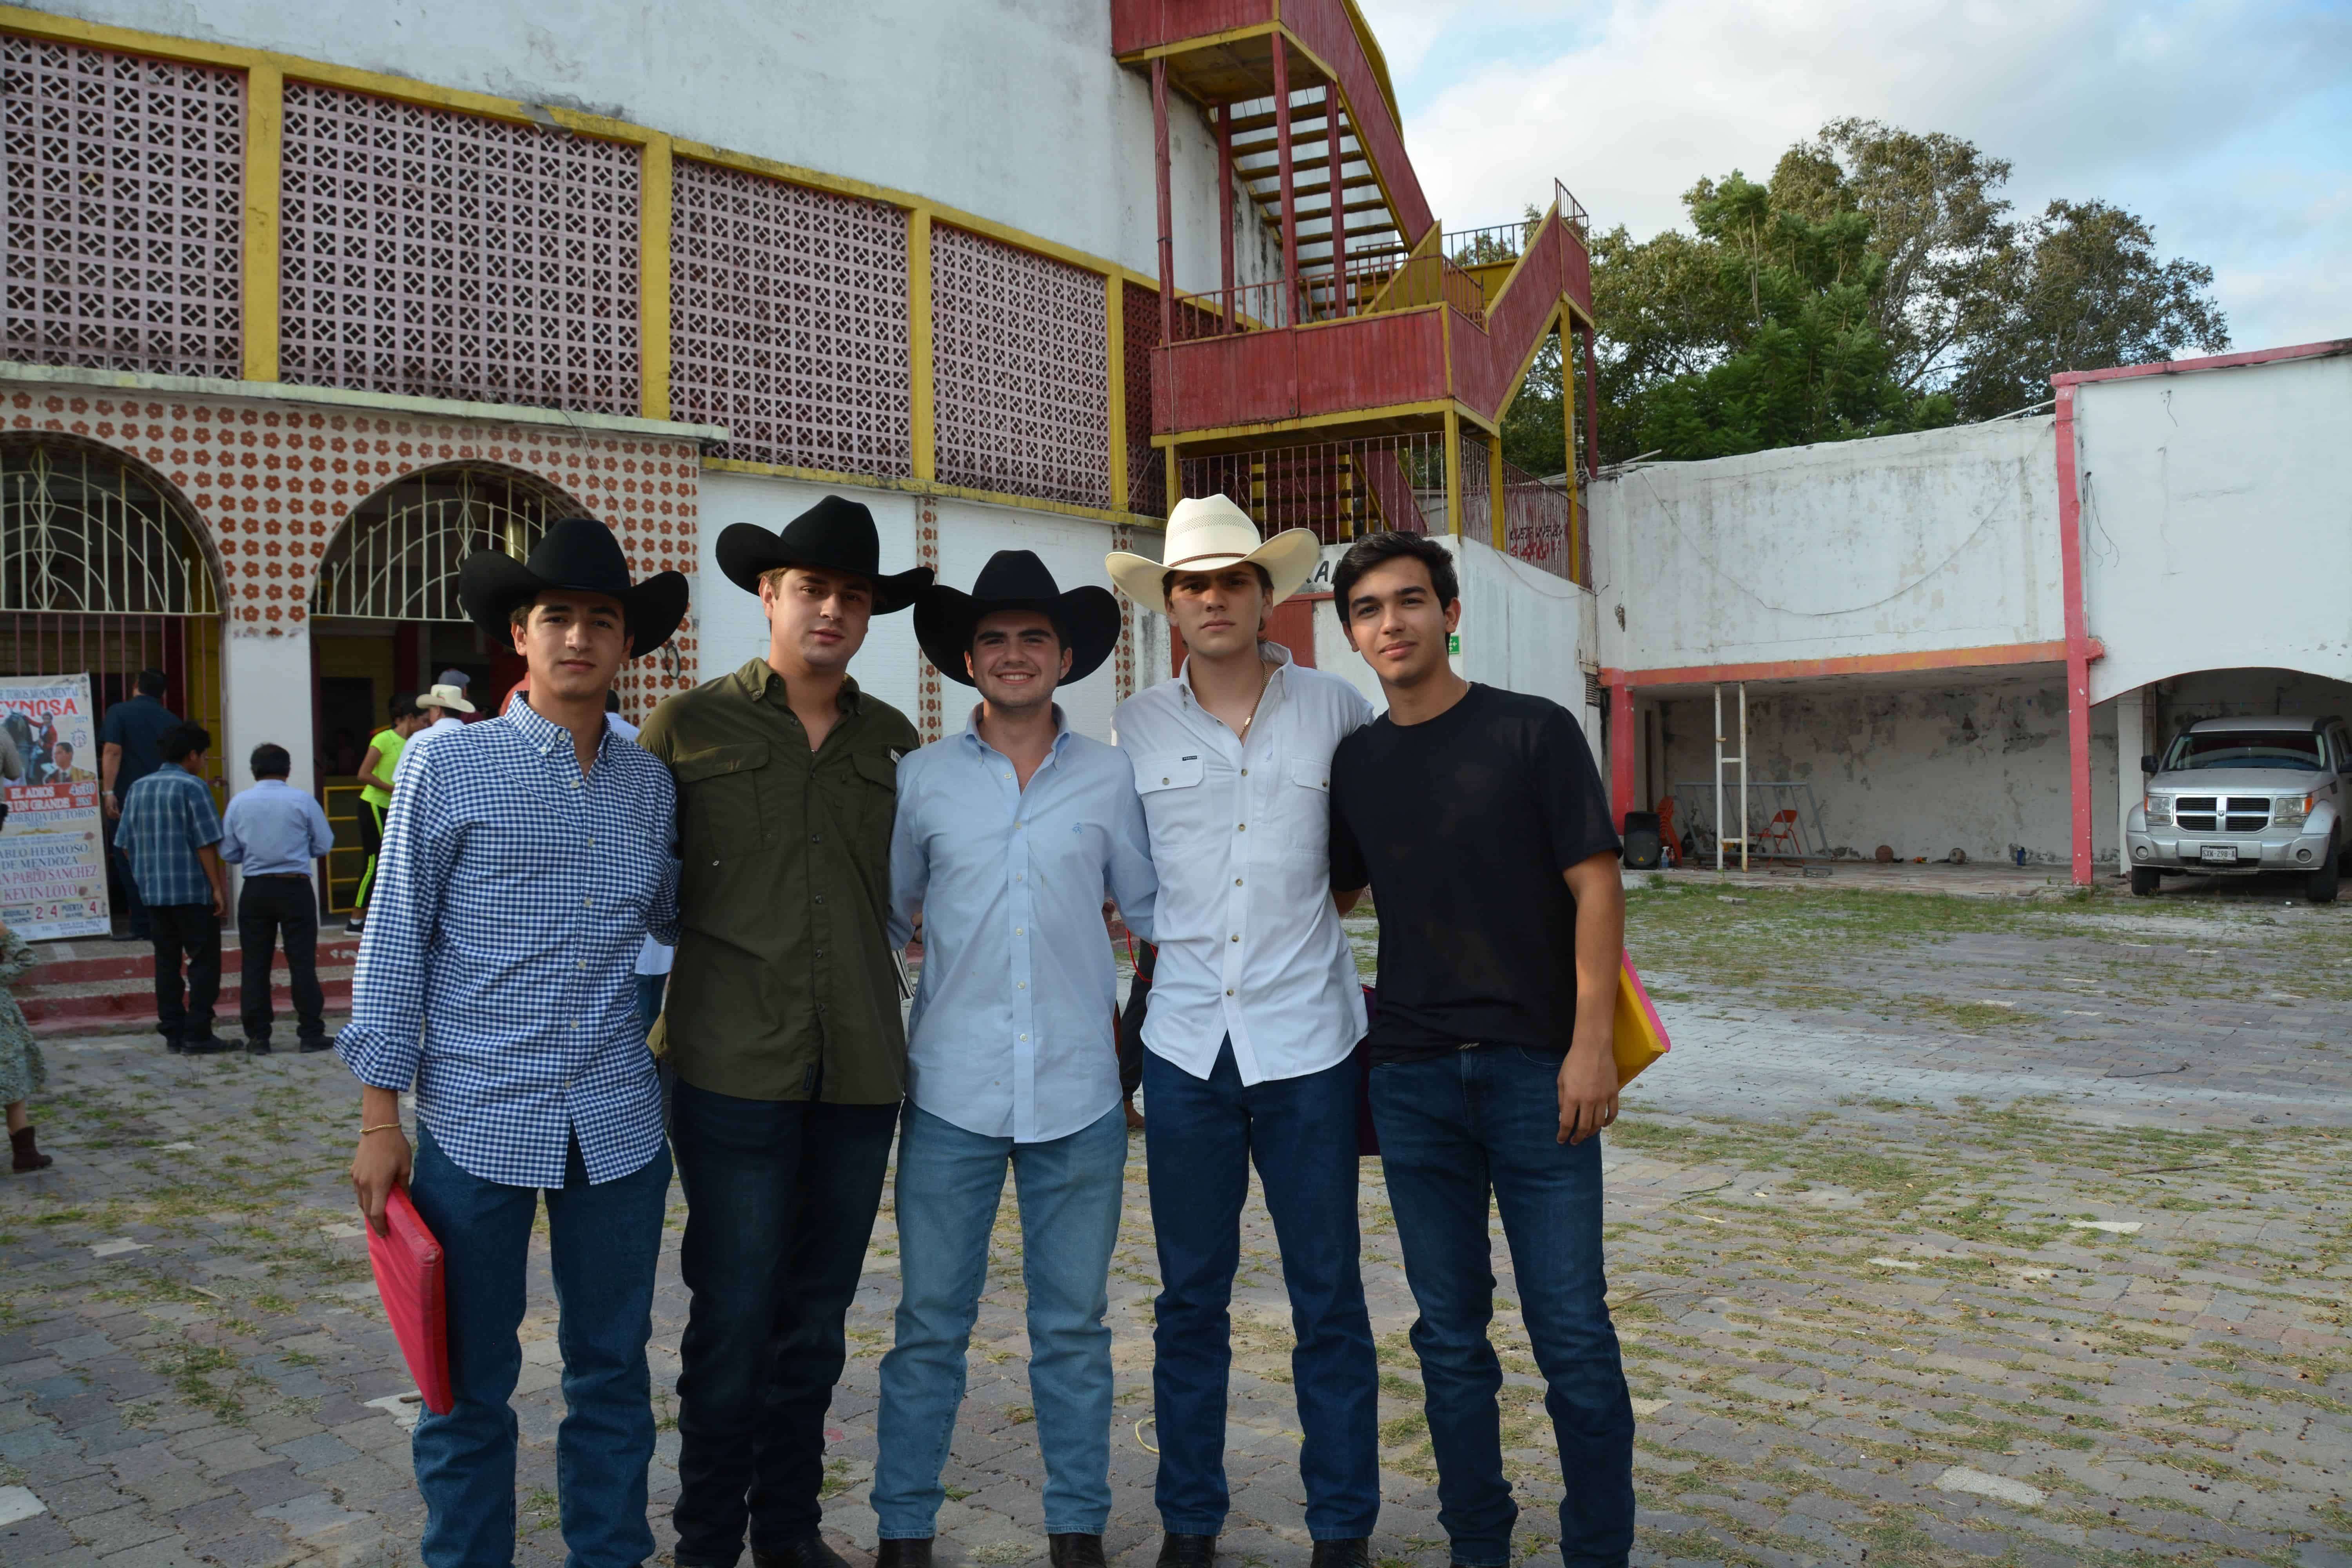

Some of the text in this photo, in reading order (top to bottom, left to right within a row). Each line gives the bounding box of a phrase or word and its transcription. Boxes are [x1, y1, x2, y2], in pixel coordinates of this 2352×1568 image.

[31, 797, 70, 810] GRANDE
[50, 811, 63, 821] DE
[66, 808, 96, 819] TOROS
[31, 843, 88, 857] HERMOSO
[2, 855, 78, 869] DE MENDOZA
[4, 884, 77, 901] KEVIN LOYO
[36, 906, 44, 919] 2
[50, 905, 58, 918] 4
[89, 901, 97, 914] 4
